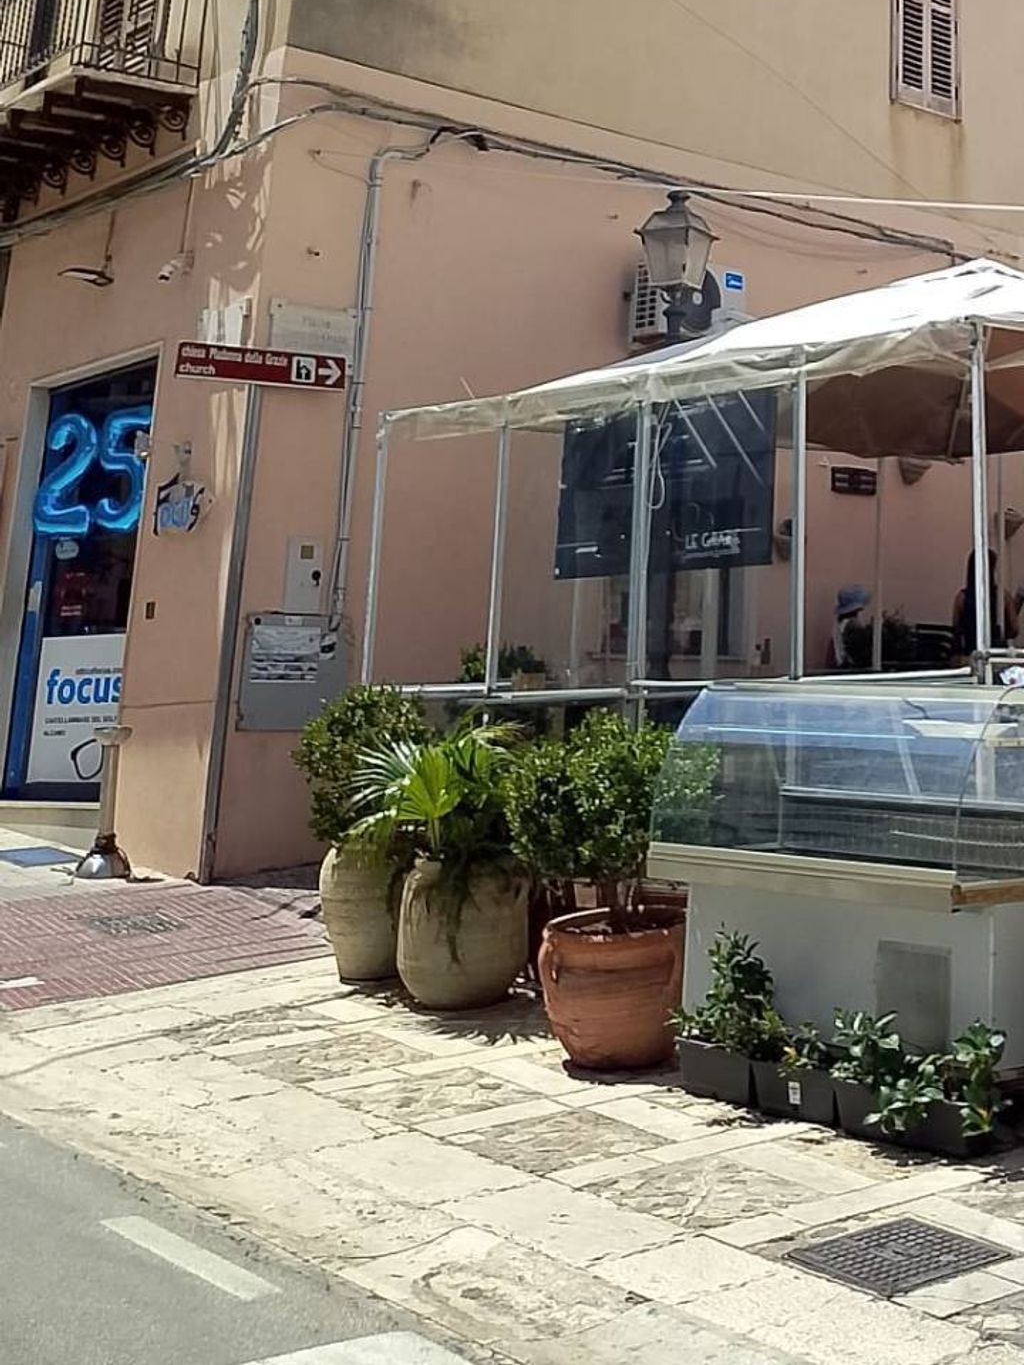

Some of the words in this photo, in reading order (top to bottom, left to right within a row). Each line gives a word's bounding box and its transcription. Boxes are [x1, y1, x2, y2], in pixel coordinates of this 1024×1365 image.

[179, 362, 216, 375] church
[33, 405, 151, 534] 25
[47, 668, 122, 705] focus
